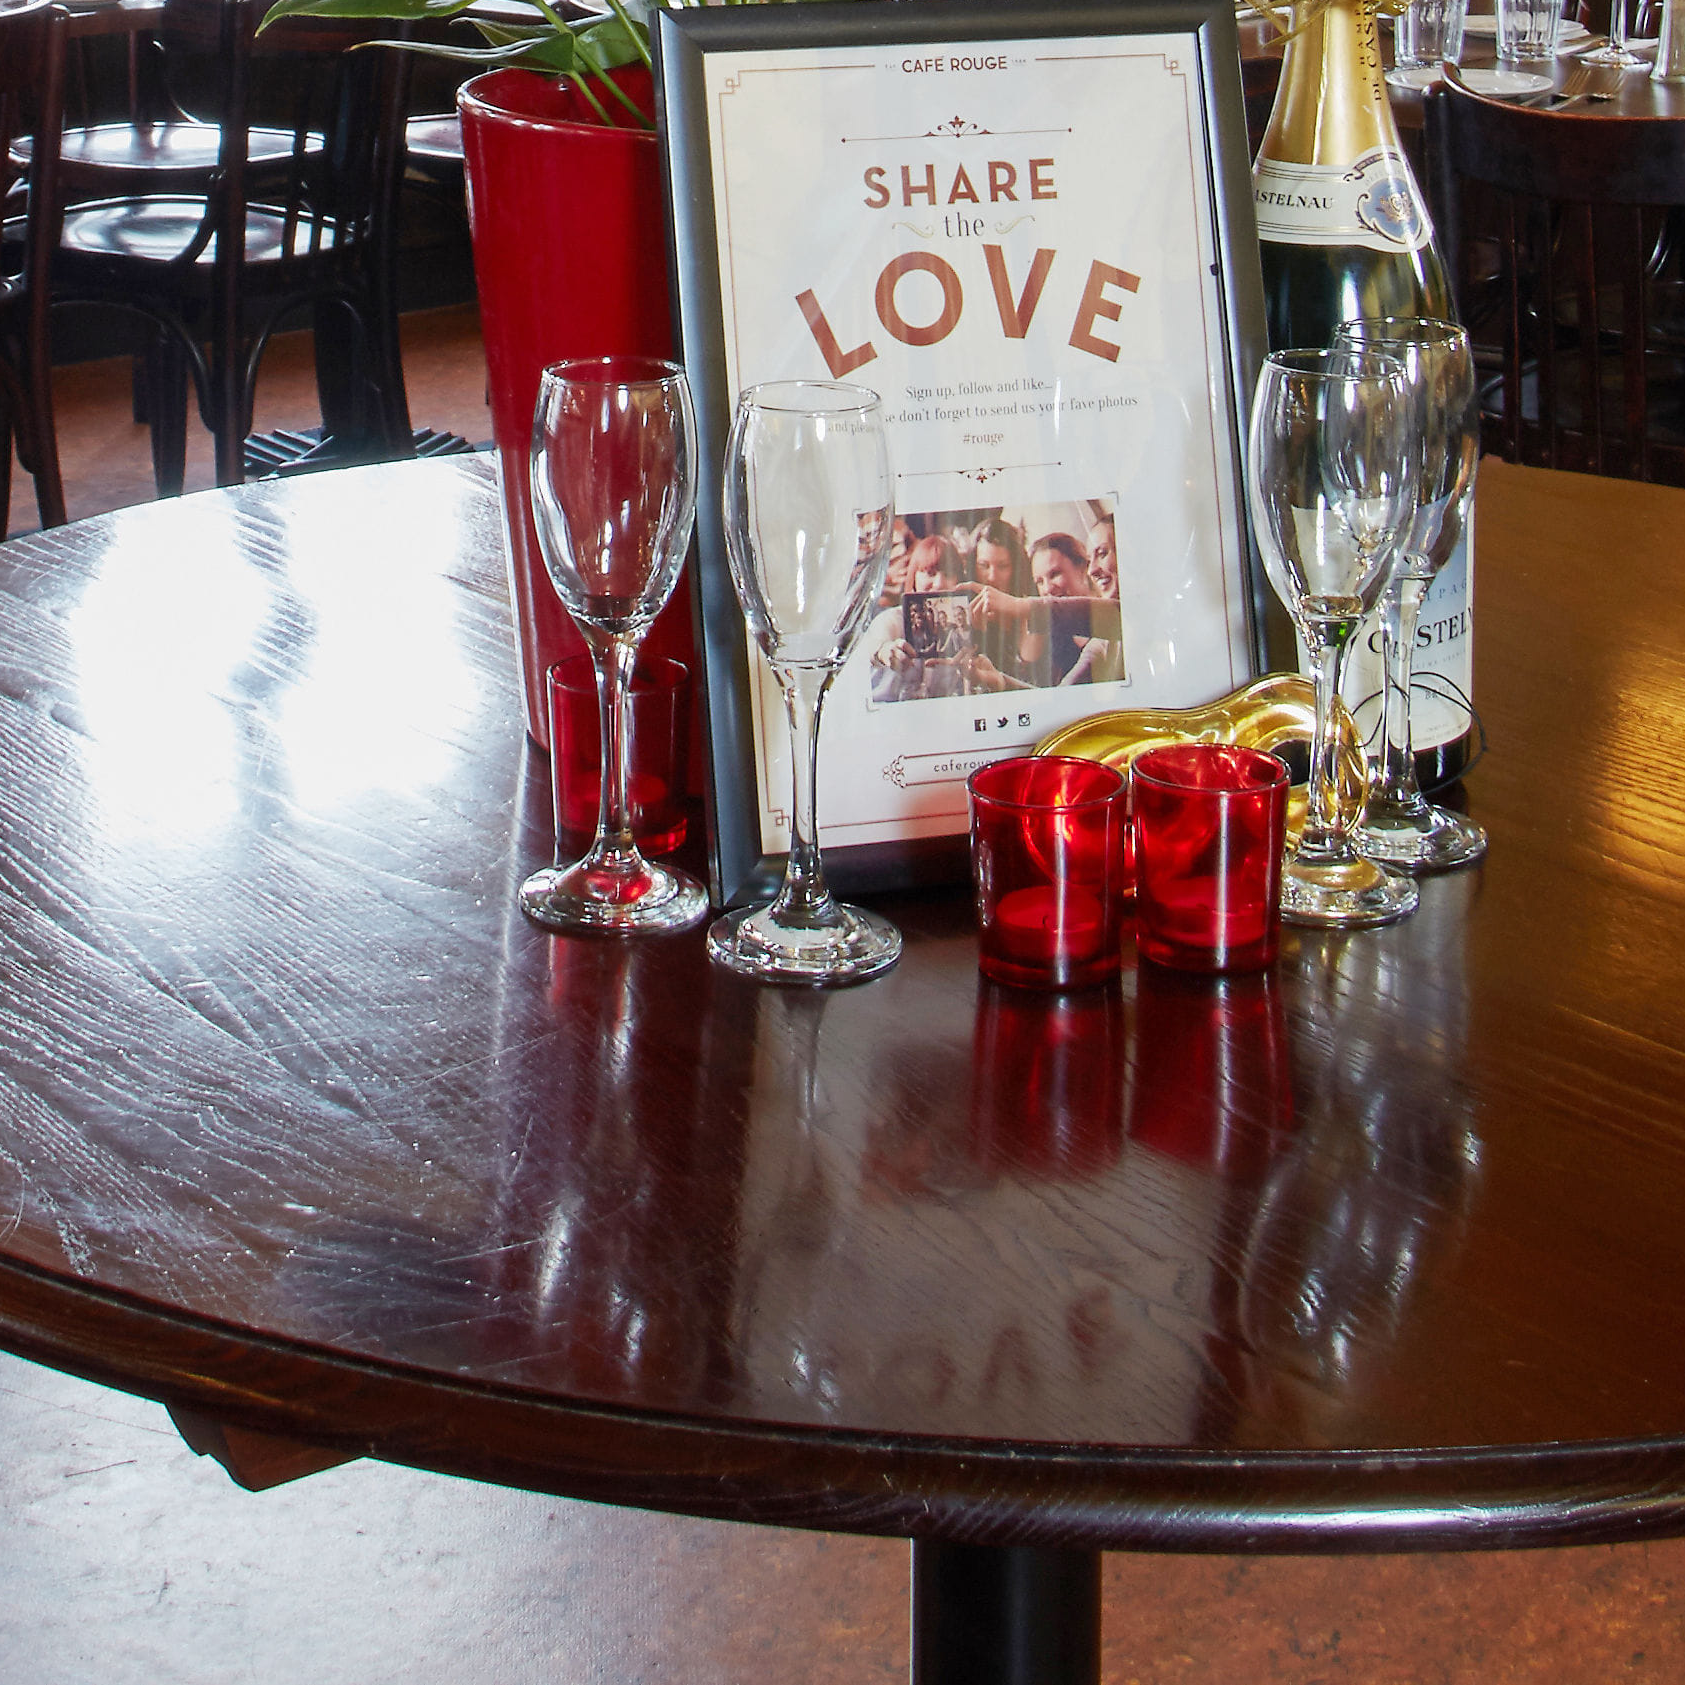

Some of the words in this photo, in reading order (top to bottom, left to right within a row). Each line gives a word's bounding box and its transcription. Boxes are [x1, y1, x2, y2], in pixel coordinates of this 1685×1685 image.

[950, 56, 1008, 72] ROUGE
[863, 158, 1058, 209] SHARE
[944, 211, 986, 238] the
[795, 243, 1142, 380] LOVE
[905, 385, 932, 402] Sign
[958, 382, 993, 396] follow
[997, 379, 1019, 393] and
[899, 409, 930, 423] don't
[934, 406, 971, 422] forget
[974, 405, 988, 417] to
[990, 401, 1018, 416] send
[1021, 403, 1036, 414] us
[1069, 397, 1095, 411] fave
[1098, 395, 1139, 412] photos
[962, 431, 1005, 447] #rouge
